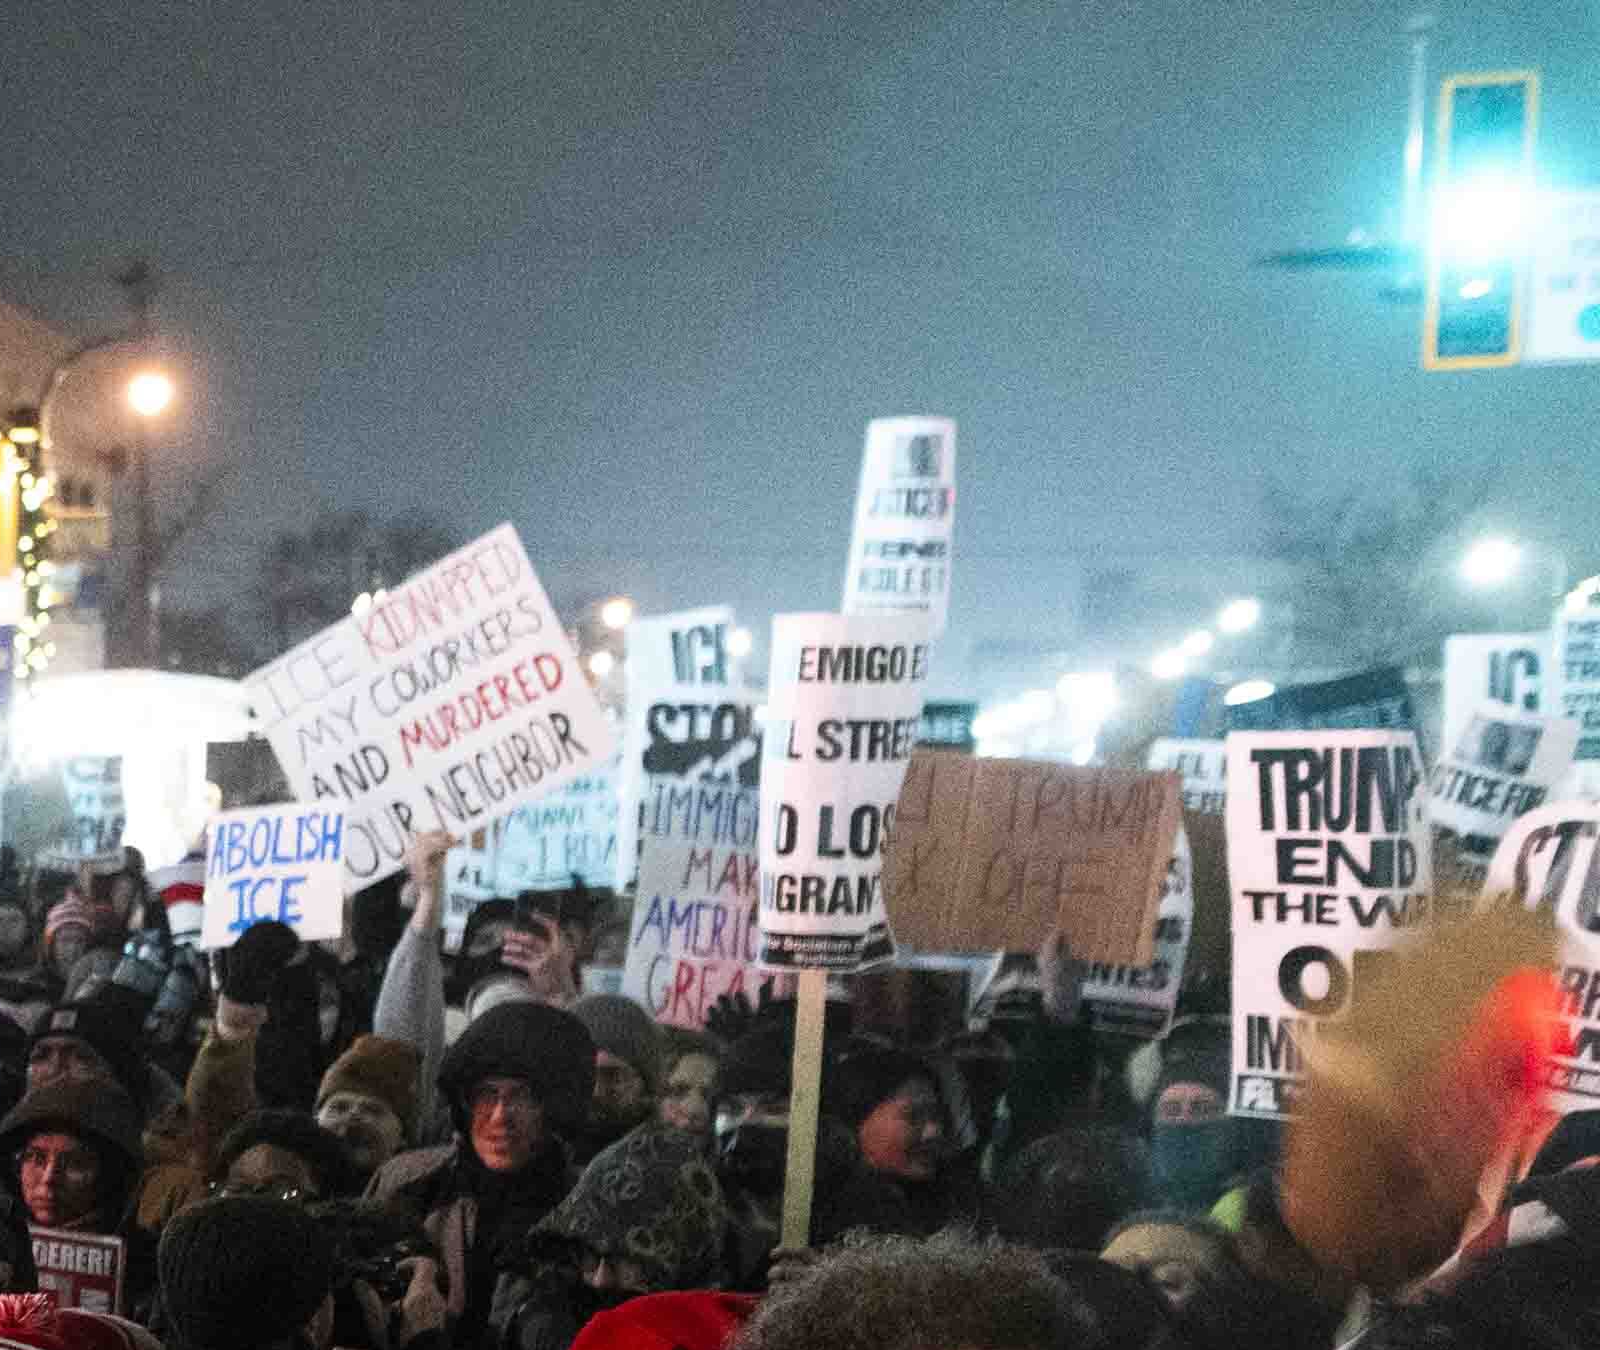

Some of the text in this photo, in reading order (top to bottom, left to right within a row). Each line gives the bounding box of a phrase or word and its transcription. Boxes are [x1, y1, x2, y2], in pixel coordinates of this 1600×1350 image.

[263, 634, 356, 720] ICE
[296, 598, 543, 763] MY COWORKERS
[798, 644, 903, 683] EMIGO
[311, 652, 564, 801] AND MURDERED
[344, 802, 417, 880] OUR
[423, 712, 591, 832] NEIGHBOR
[209, 812, 344, 877] ABOLISH
[227, 874, 307, 934] ICE
[1243, 890, 1340, 926] THE
